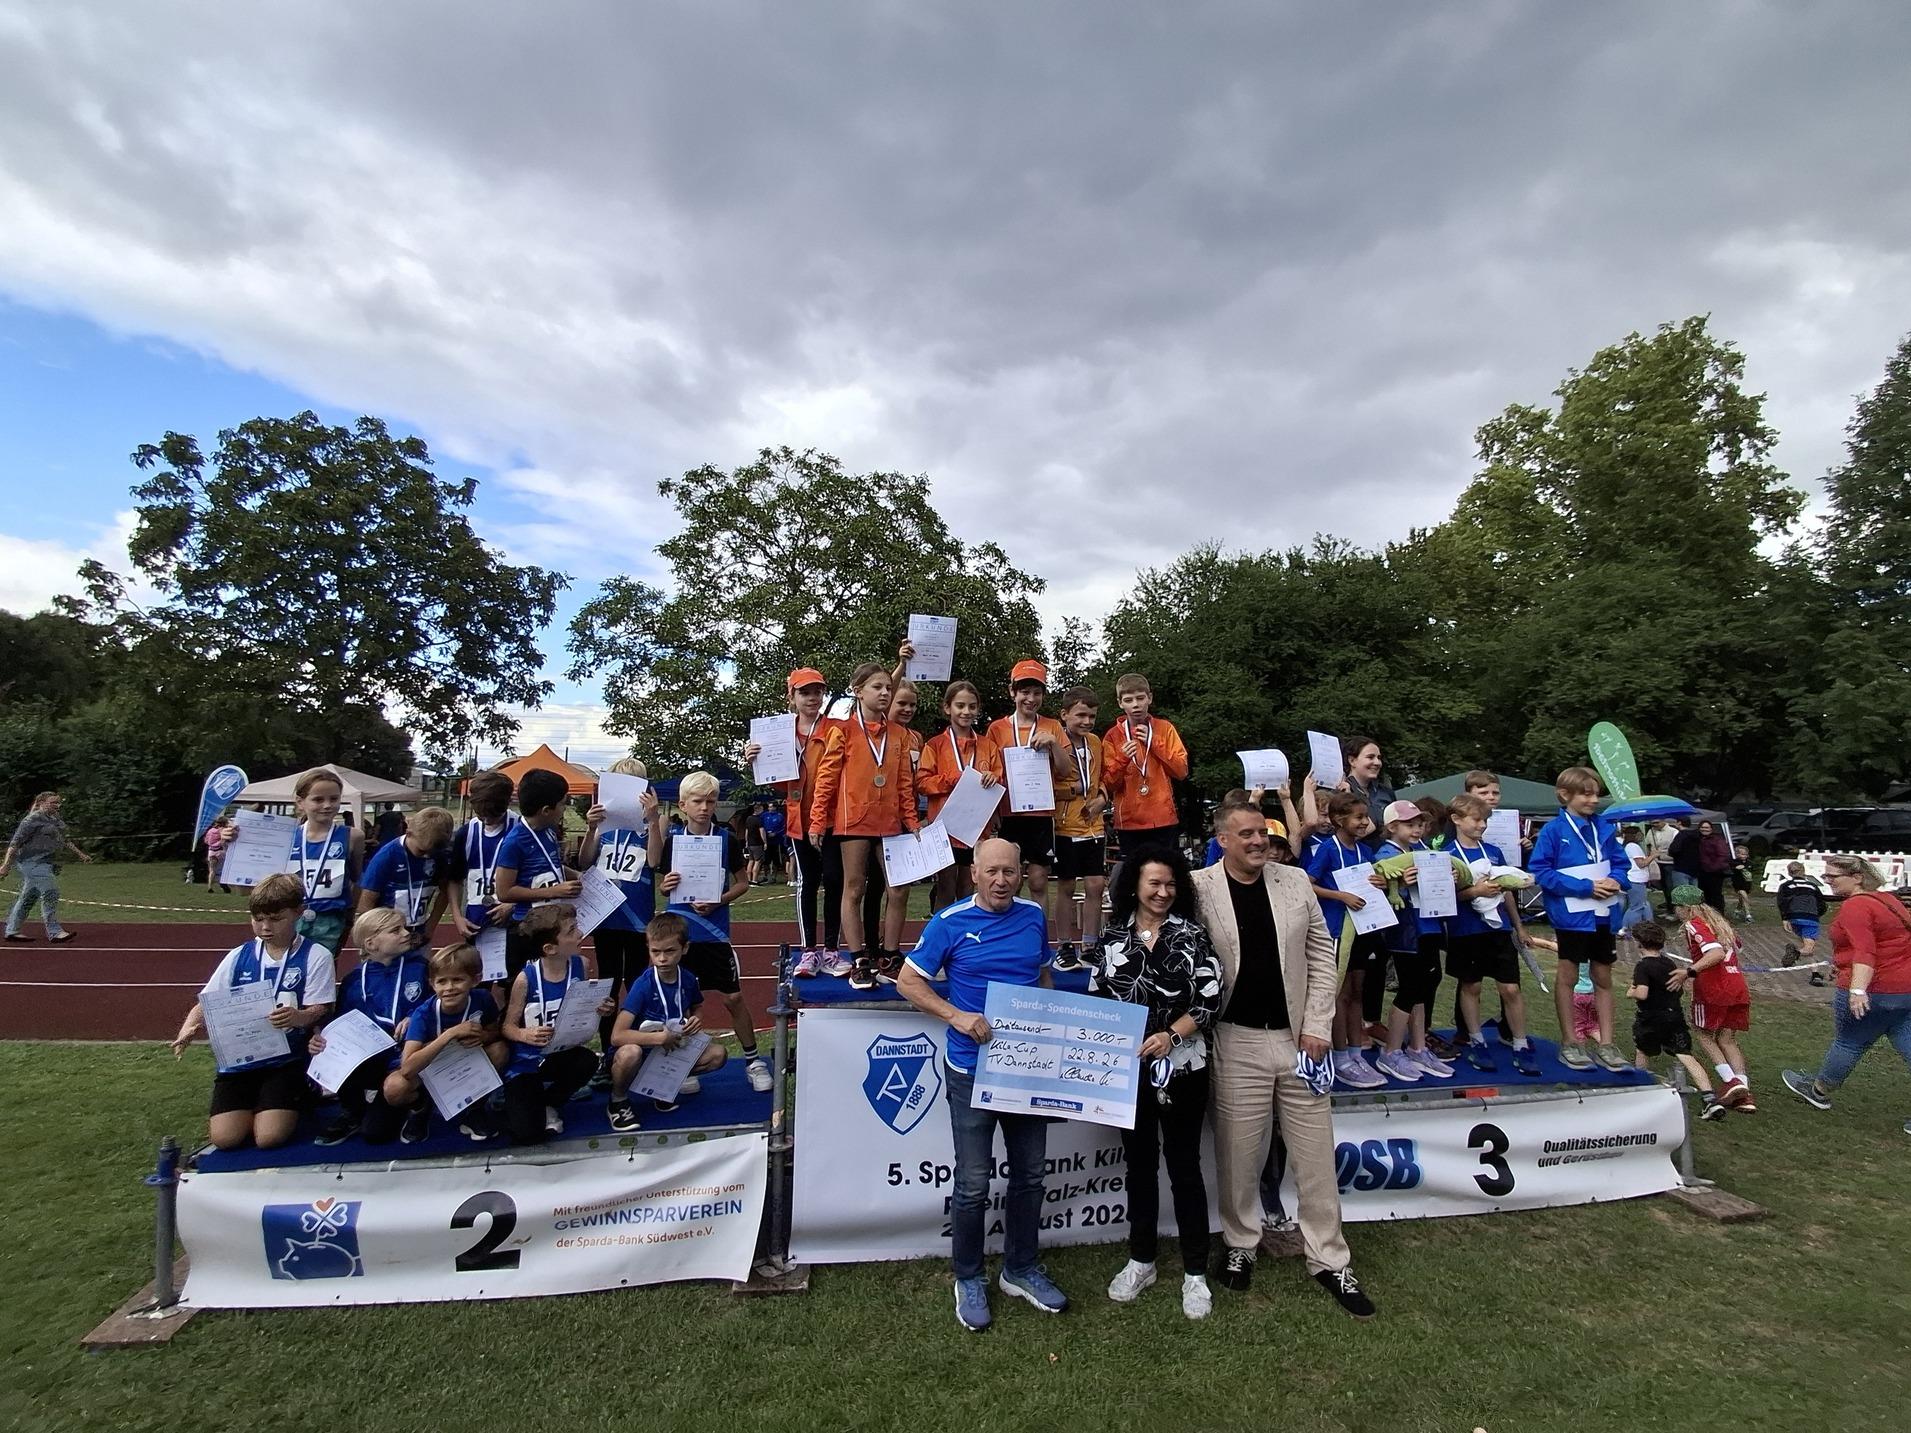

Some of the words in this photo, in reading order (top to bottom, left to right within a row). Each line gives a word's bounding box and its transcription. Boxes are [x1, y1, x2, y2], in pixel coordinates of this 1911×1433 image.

[1010, 997, 1122, 1023] Sparda-Spendenscheck
[875, 1043, 929, 1057] DANNSTADT
[905, 1083, 926, 1111] 1888
[1543, 1132, 1657, 1154] Qualitätssicherung
[1467, 1123, 1516, 1197] 3
[1537, 1156, 1561, 1168] und
[887, 1162, 911, 1187] 5.
[553, 1207, 573, 1217] Mit
[646, 1184, 720, 1200] Unterstützung
[723, 1183, 745, 1193] vom
[554, 1199, 742, 1231] GEWINNSPARVEREIN
[1081, 1203, 1127, 1227] 202
[449, 1190, 522, 1273] 2
[556, 1238, 574, 1249] der
[576, 1234, 644, 1250] Sparda-Bank
[647, 1229, 694, 1244] Südwest
[696, 1226, 715, 1238] e.V.
